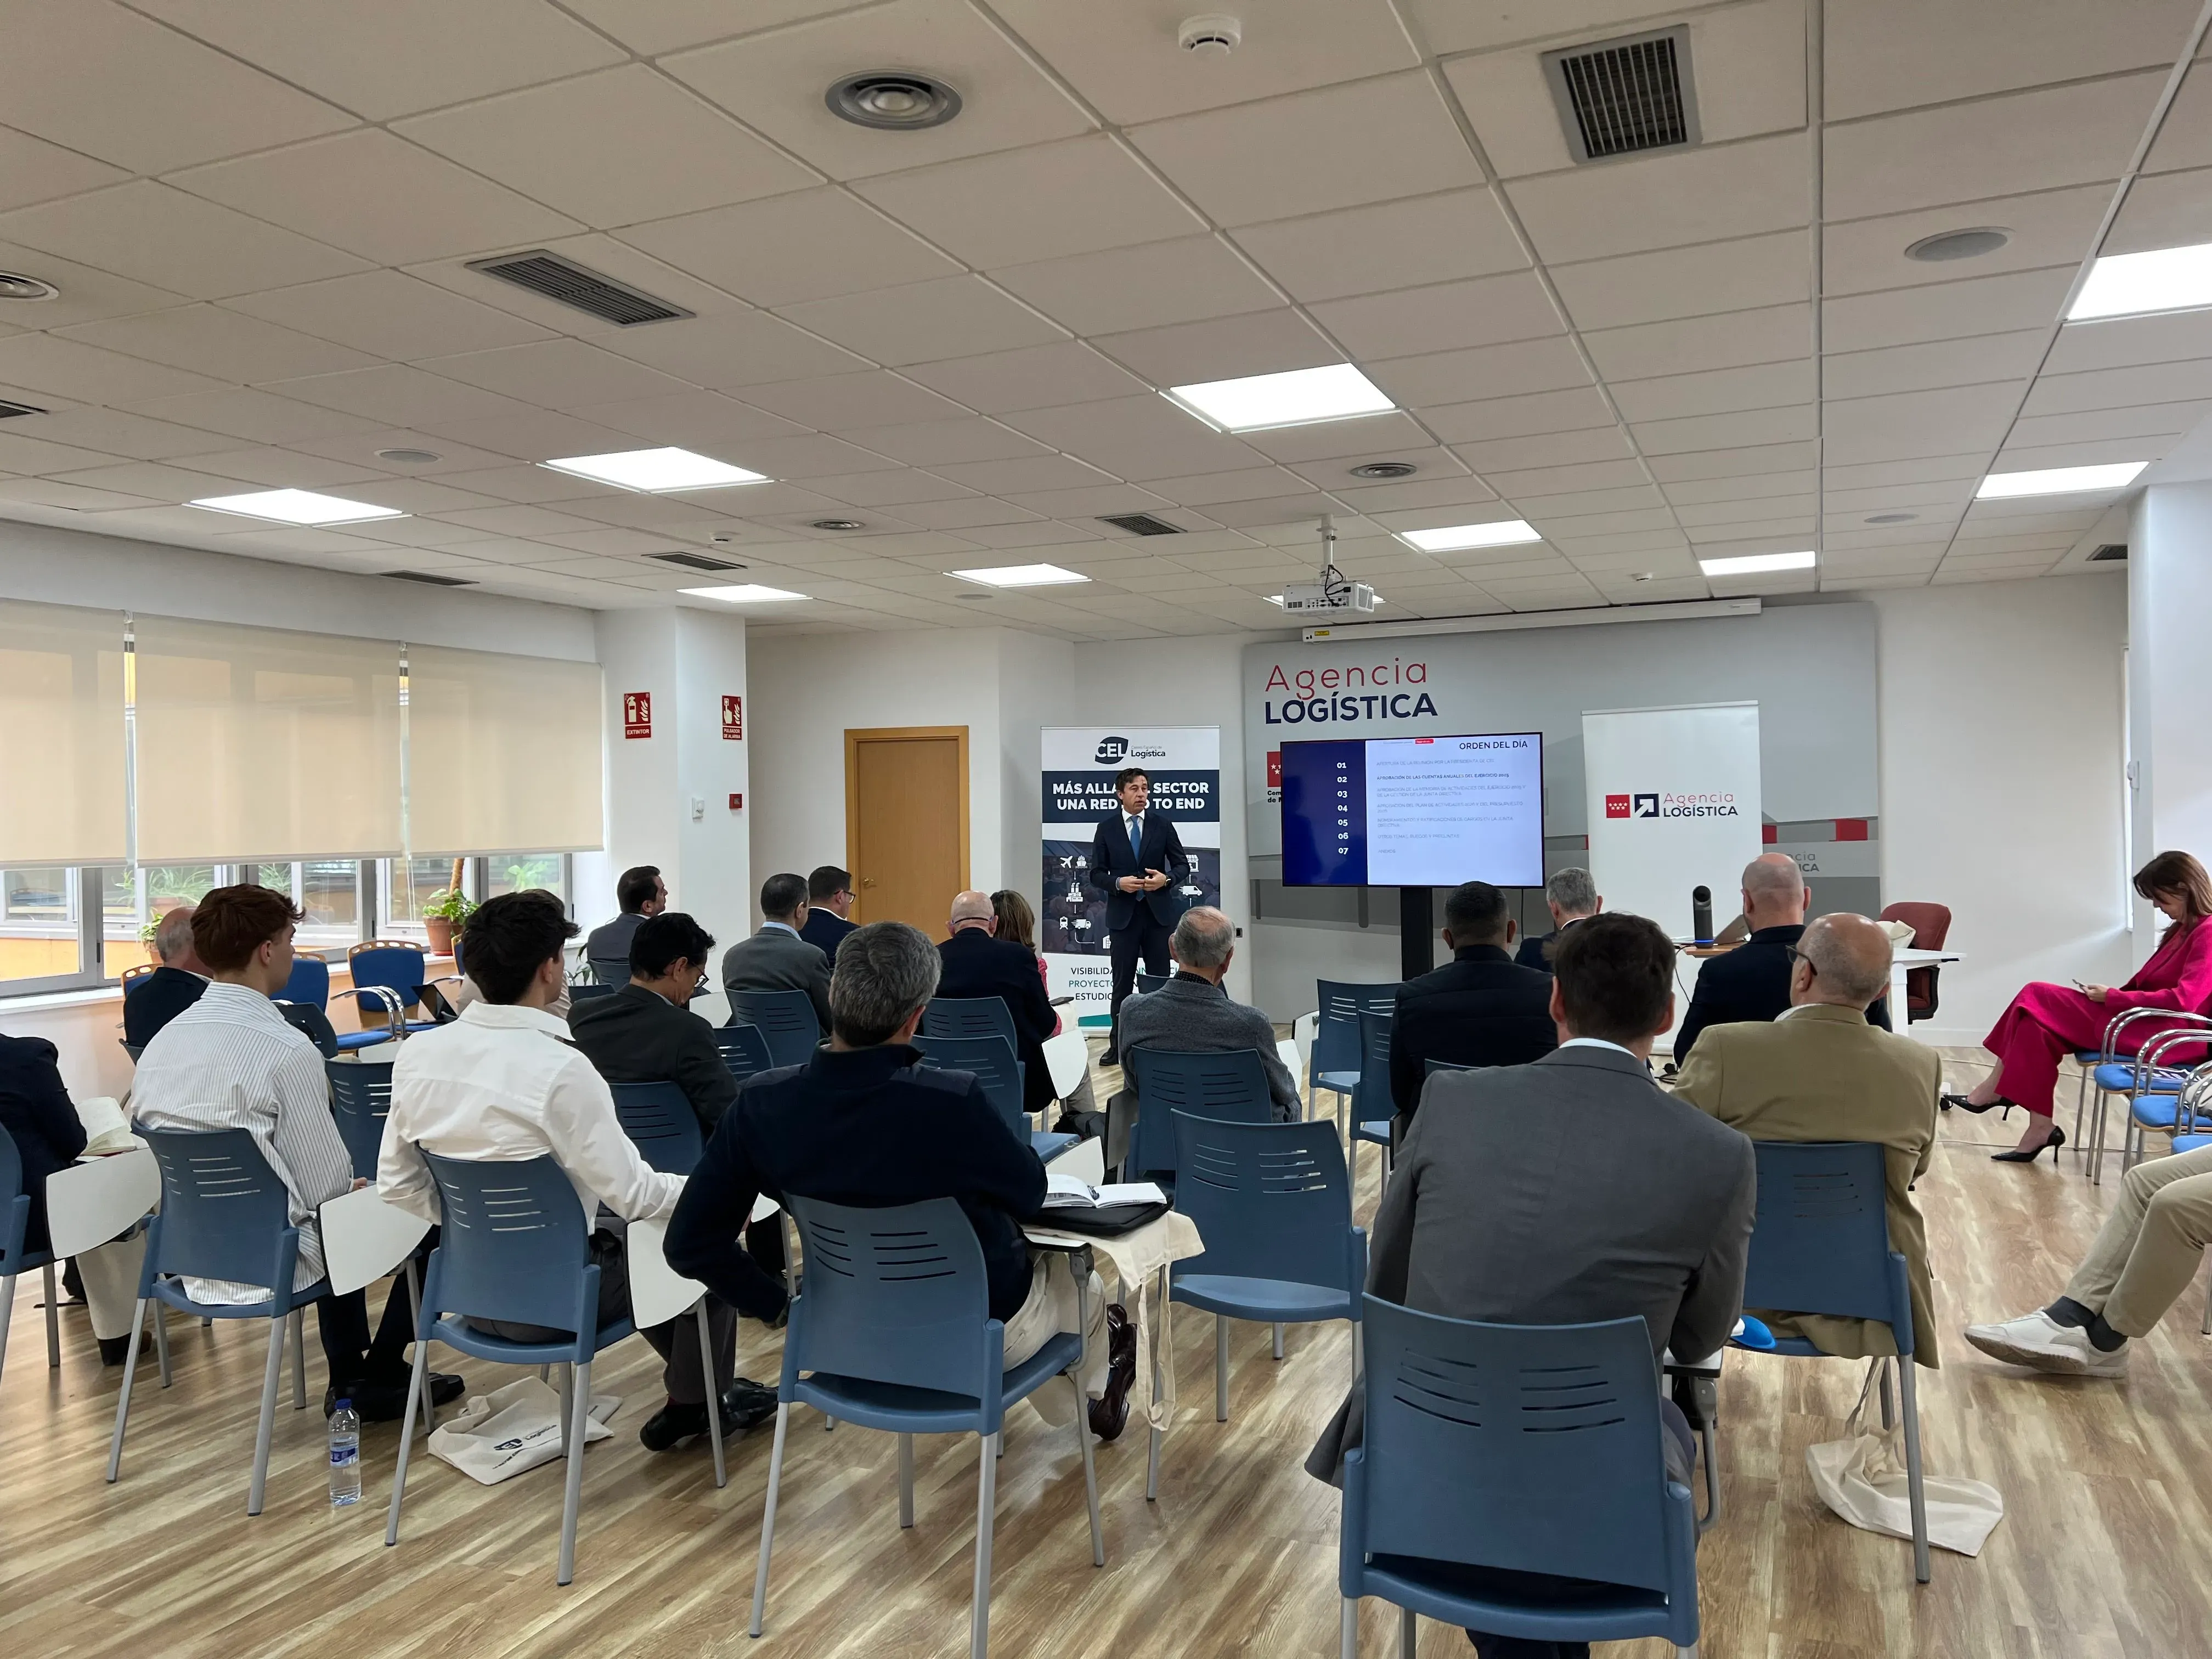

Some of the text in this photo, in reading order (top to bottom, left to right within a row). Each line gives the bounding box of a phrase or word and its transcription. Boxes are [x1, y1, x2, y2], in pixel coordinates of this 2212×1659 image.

[1265, 658, 1426, 701] Agencia
[1265, 691, 1438, 724] LOGÍSTICA
[1096, 743, 1126, 757] CEL
[1459, 742, 1491, 750] ORDEN
[1513, 739, 1528, 748] DÍA
[1131, 749, 1166, 759] Logística
[1053, 780, 1082, 794] MÁS
[1153, 782, 1209, 794] SECTOR
[1057, 799, 1087, 810] UNA
[1090, 798, 1118, 810] RED
[1153, 798, 1172, 810] TO
[1176, 798, 1205, 809] END
[1663, 791, 1734, 808] Agencia
[1663, 804, 1739, 817] LOGÍSTICA
